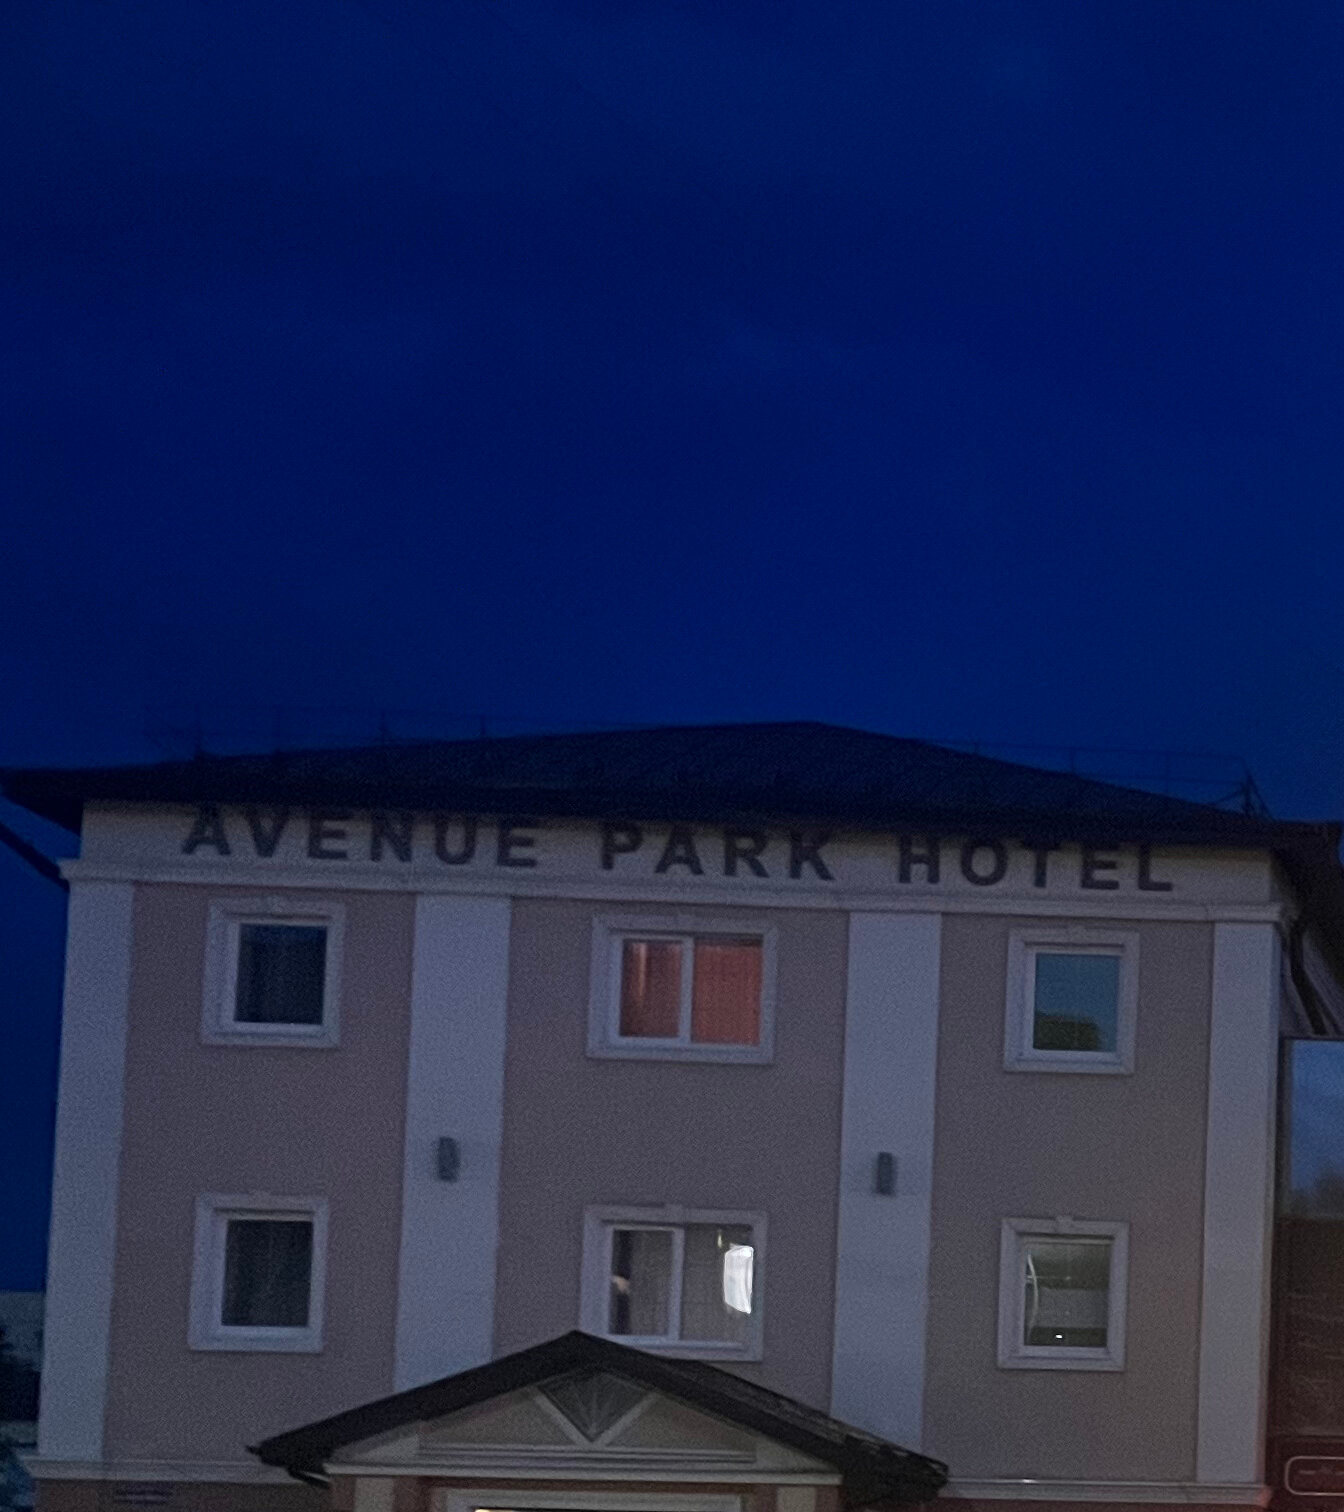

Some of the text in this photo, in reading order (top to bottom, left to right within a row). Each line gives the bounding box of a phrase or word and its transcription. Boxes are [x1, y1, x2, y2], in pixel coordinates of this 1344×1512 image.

[182, 803, 1175, 893] AVENUE PARK HOTEL
